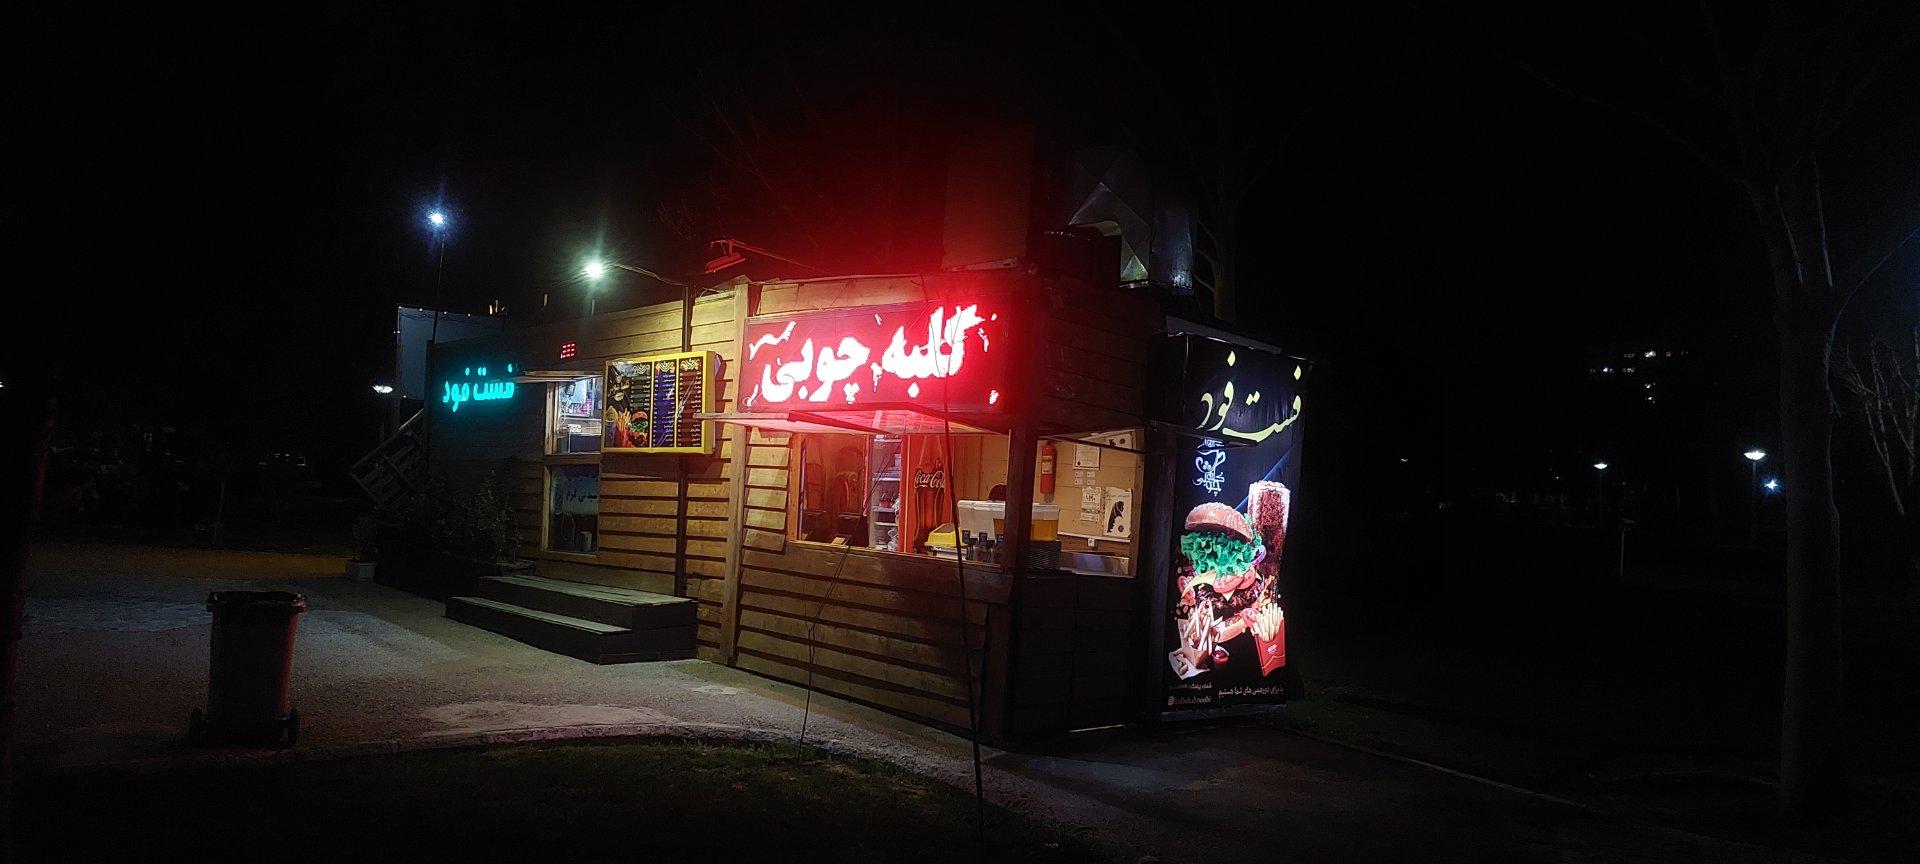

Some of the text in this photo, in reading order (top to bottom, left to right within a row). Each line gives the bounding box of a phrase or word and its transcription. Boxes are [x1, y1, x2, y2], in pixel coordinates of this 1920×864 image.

[442, 363, 516, 412] فست فود
[761, 304, 986, 404] کلبه چوبی
[1196, 351, 1301, 442] فست فود
